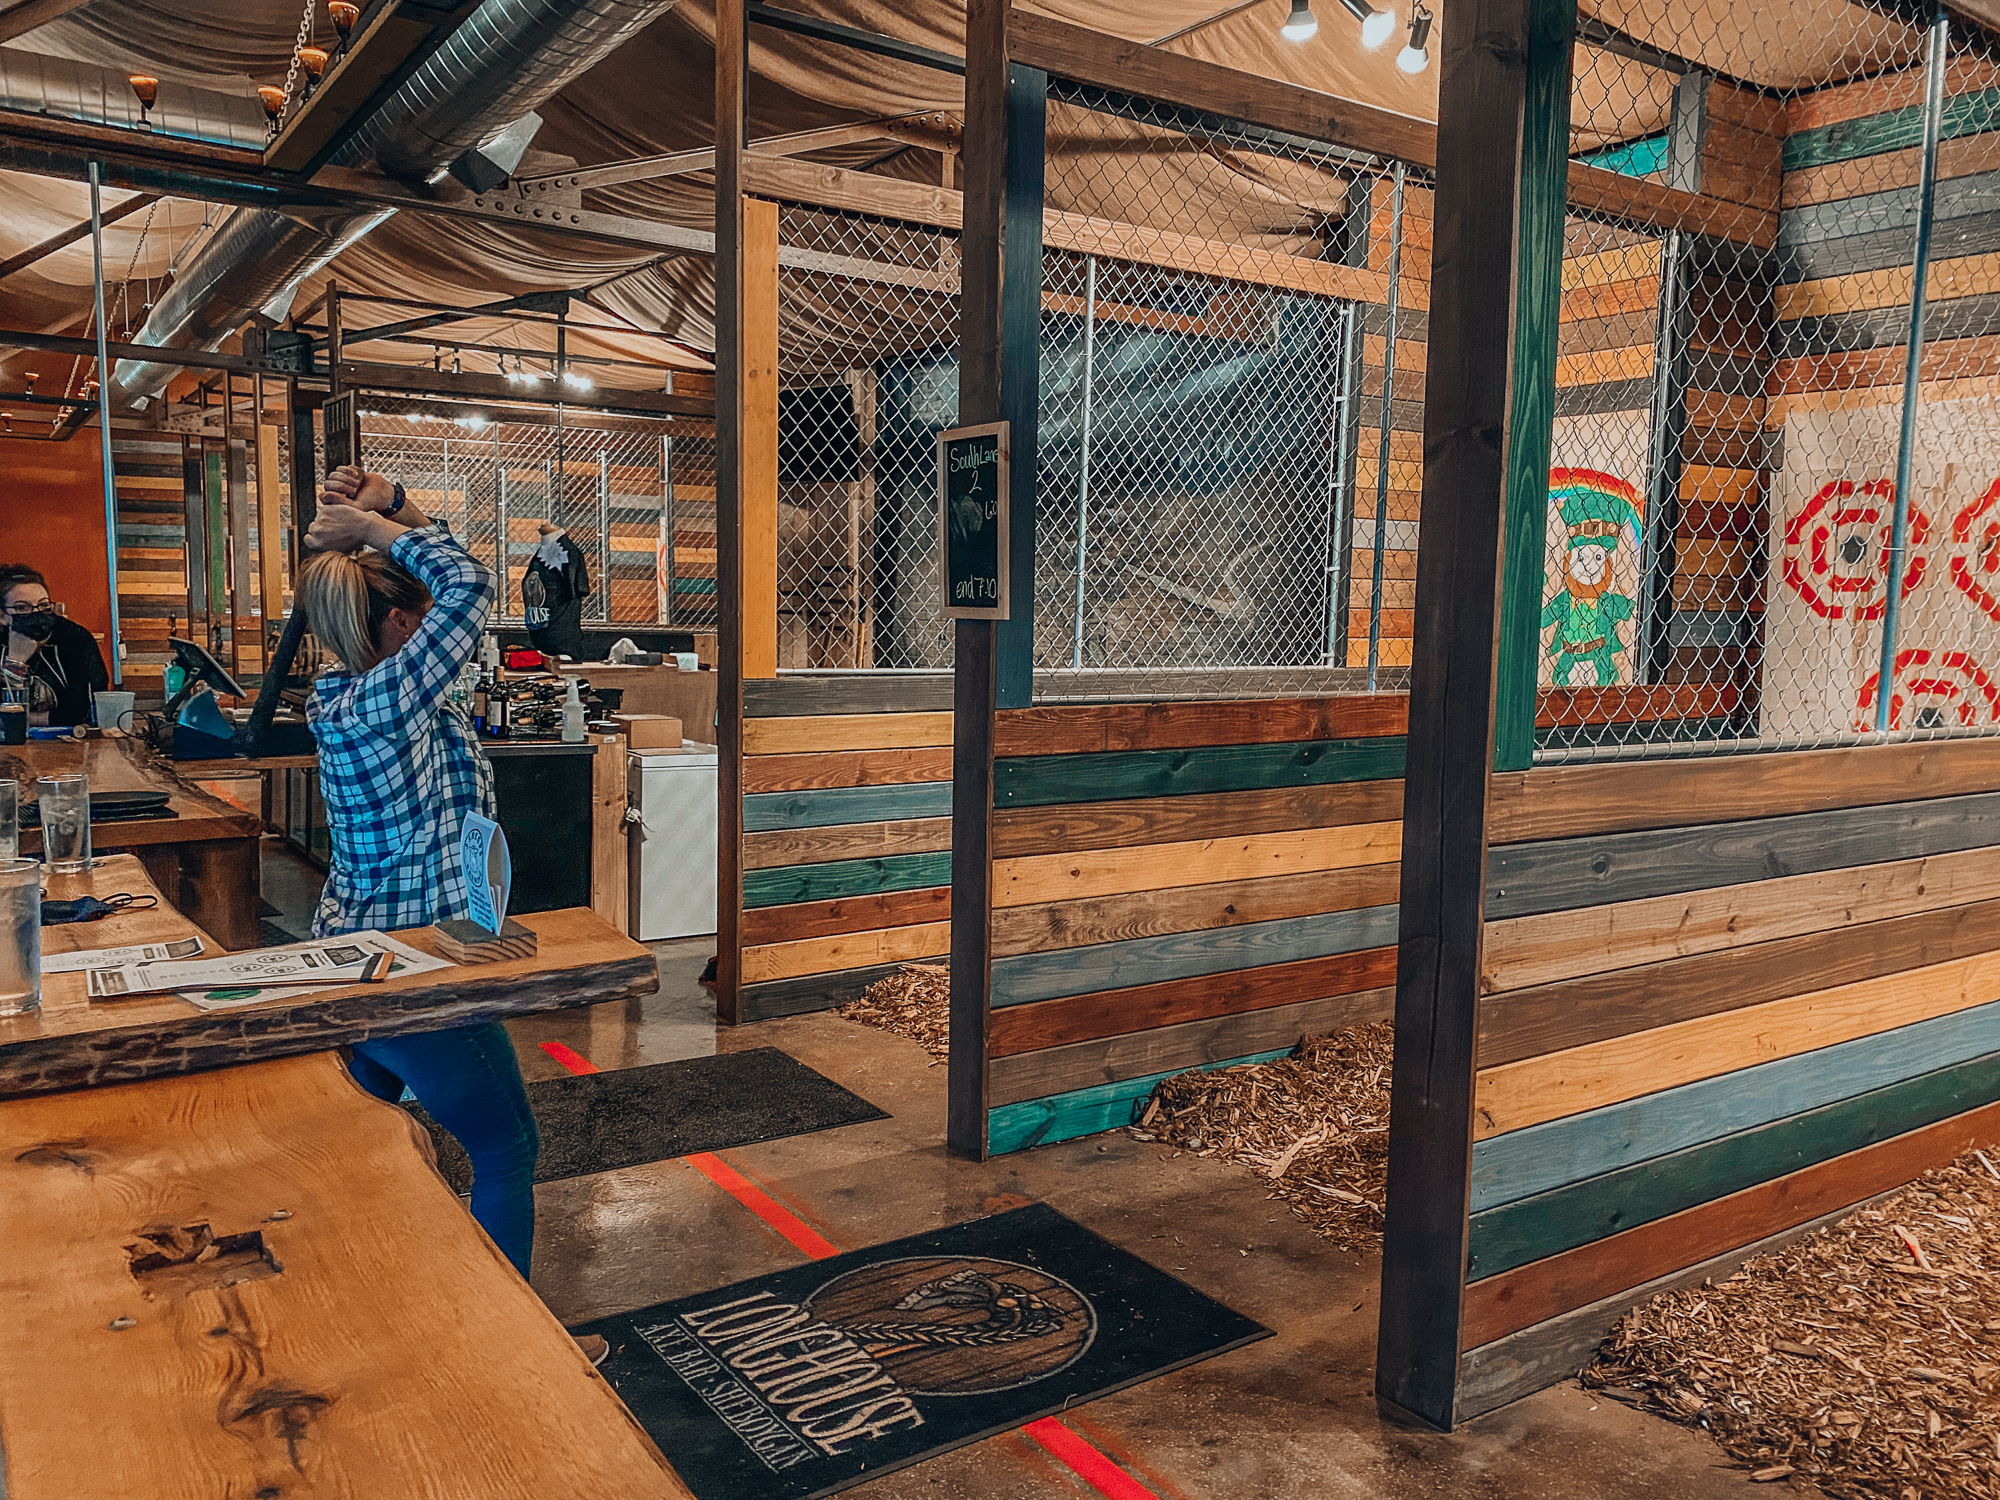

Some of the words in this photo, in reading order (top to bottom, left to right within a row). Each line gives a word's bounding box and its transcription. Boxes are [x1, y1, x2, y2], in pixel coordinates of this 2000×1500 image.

[968, 469, 982, 494] 2
[956, 574, 974, 599] end
[639, 1323, 694, 1352] AXE
[666, 1348, 720, 1380] BAR
[680, 1291, 925, 1456] LONGHOUSE
[701, 1380, 814, 1470] SHEBOYGAN
